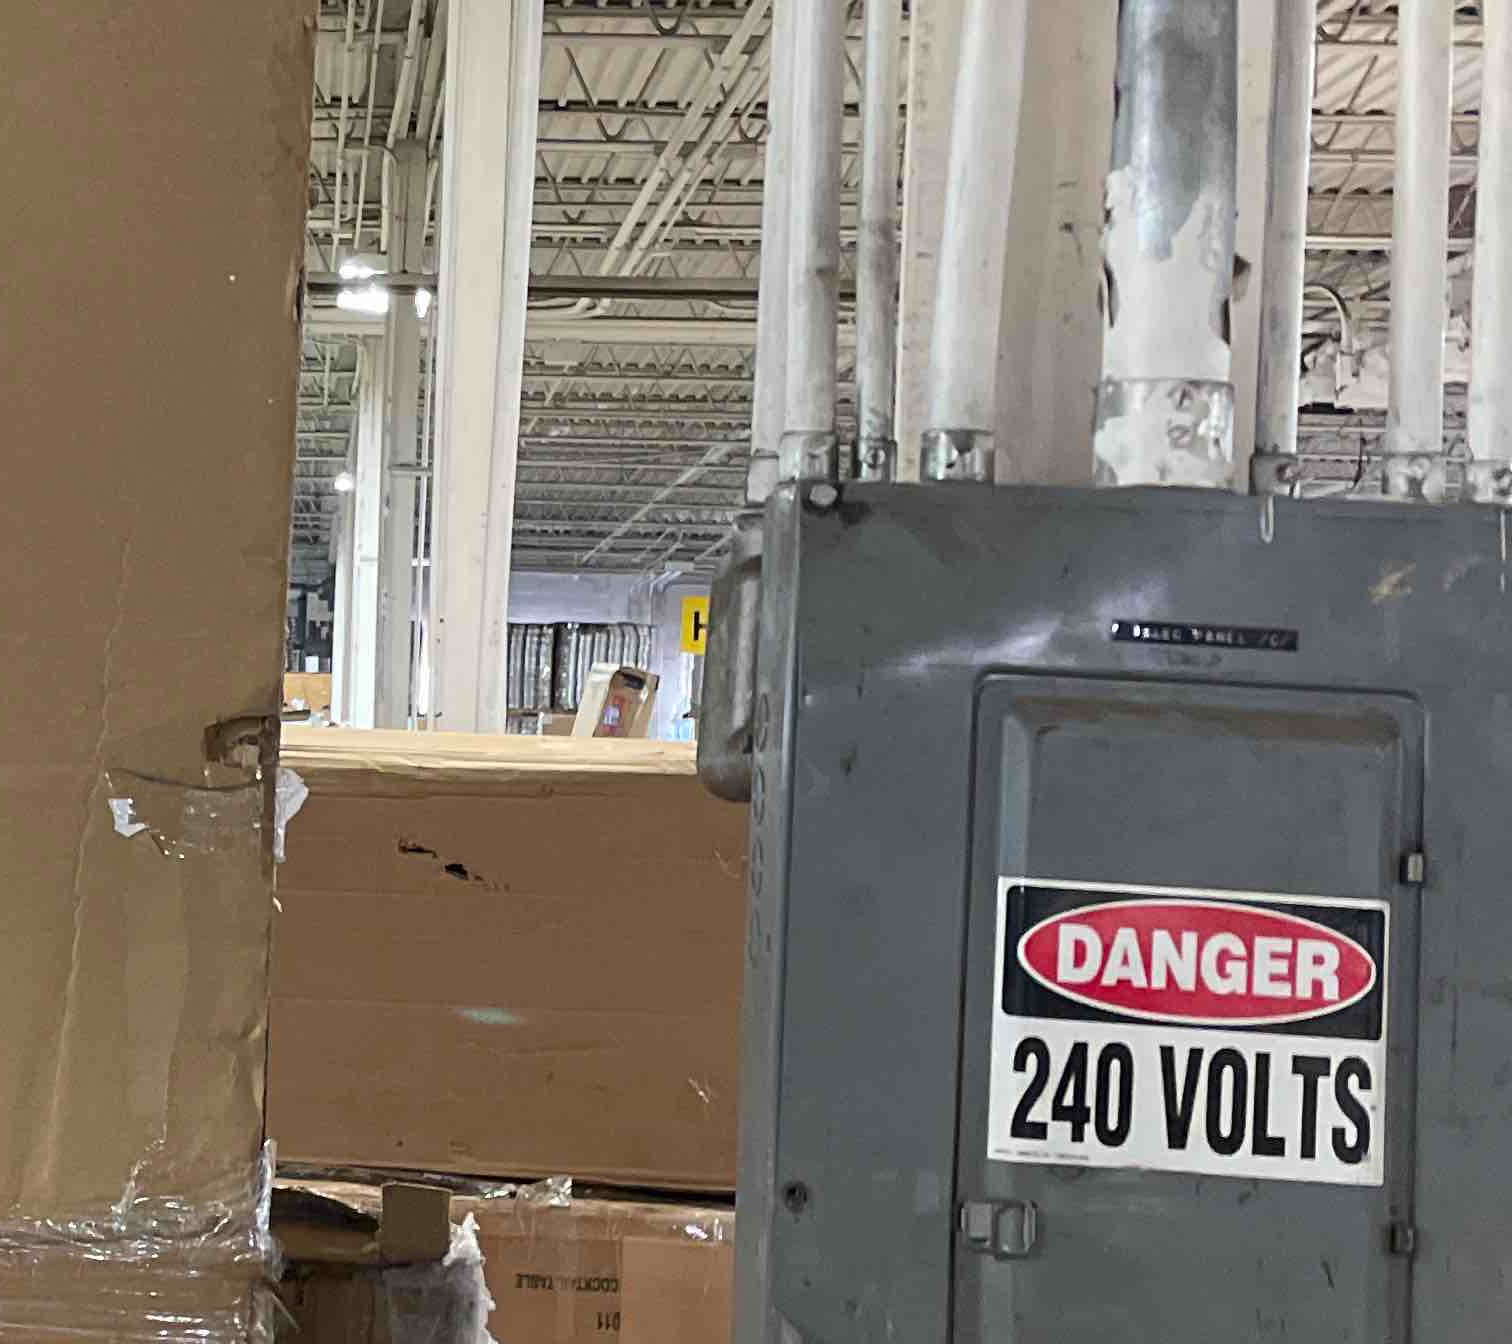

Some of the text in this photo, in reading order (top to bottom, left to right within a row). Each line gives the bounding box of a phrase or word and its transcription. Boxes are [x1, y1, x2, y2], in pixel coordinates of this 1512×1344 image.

[1056, 923, 1340, 1001] DANGER
[1010, 1037, 1373, 1164] 240 VOLTS
